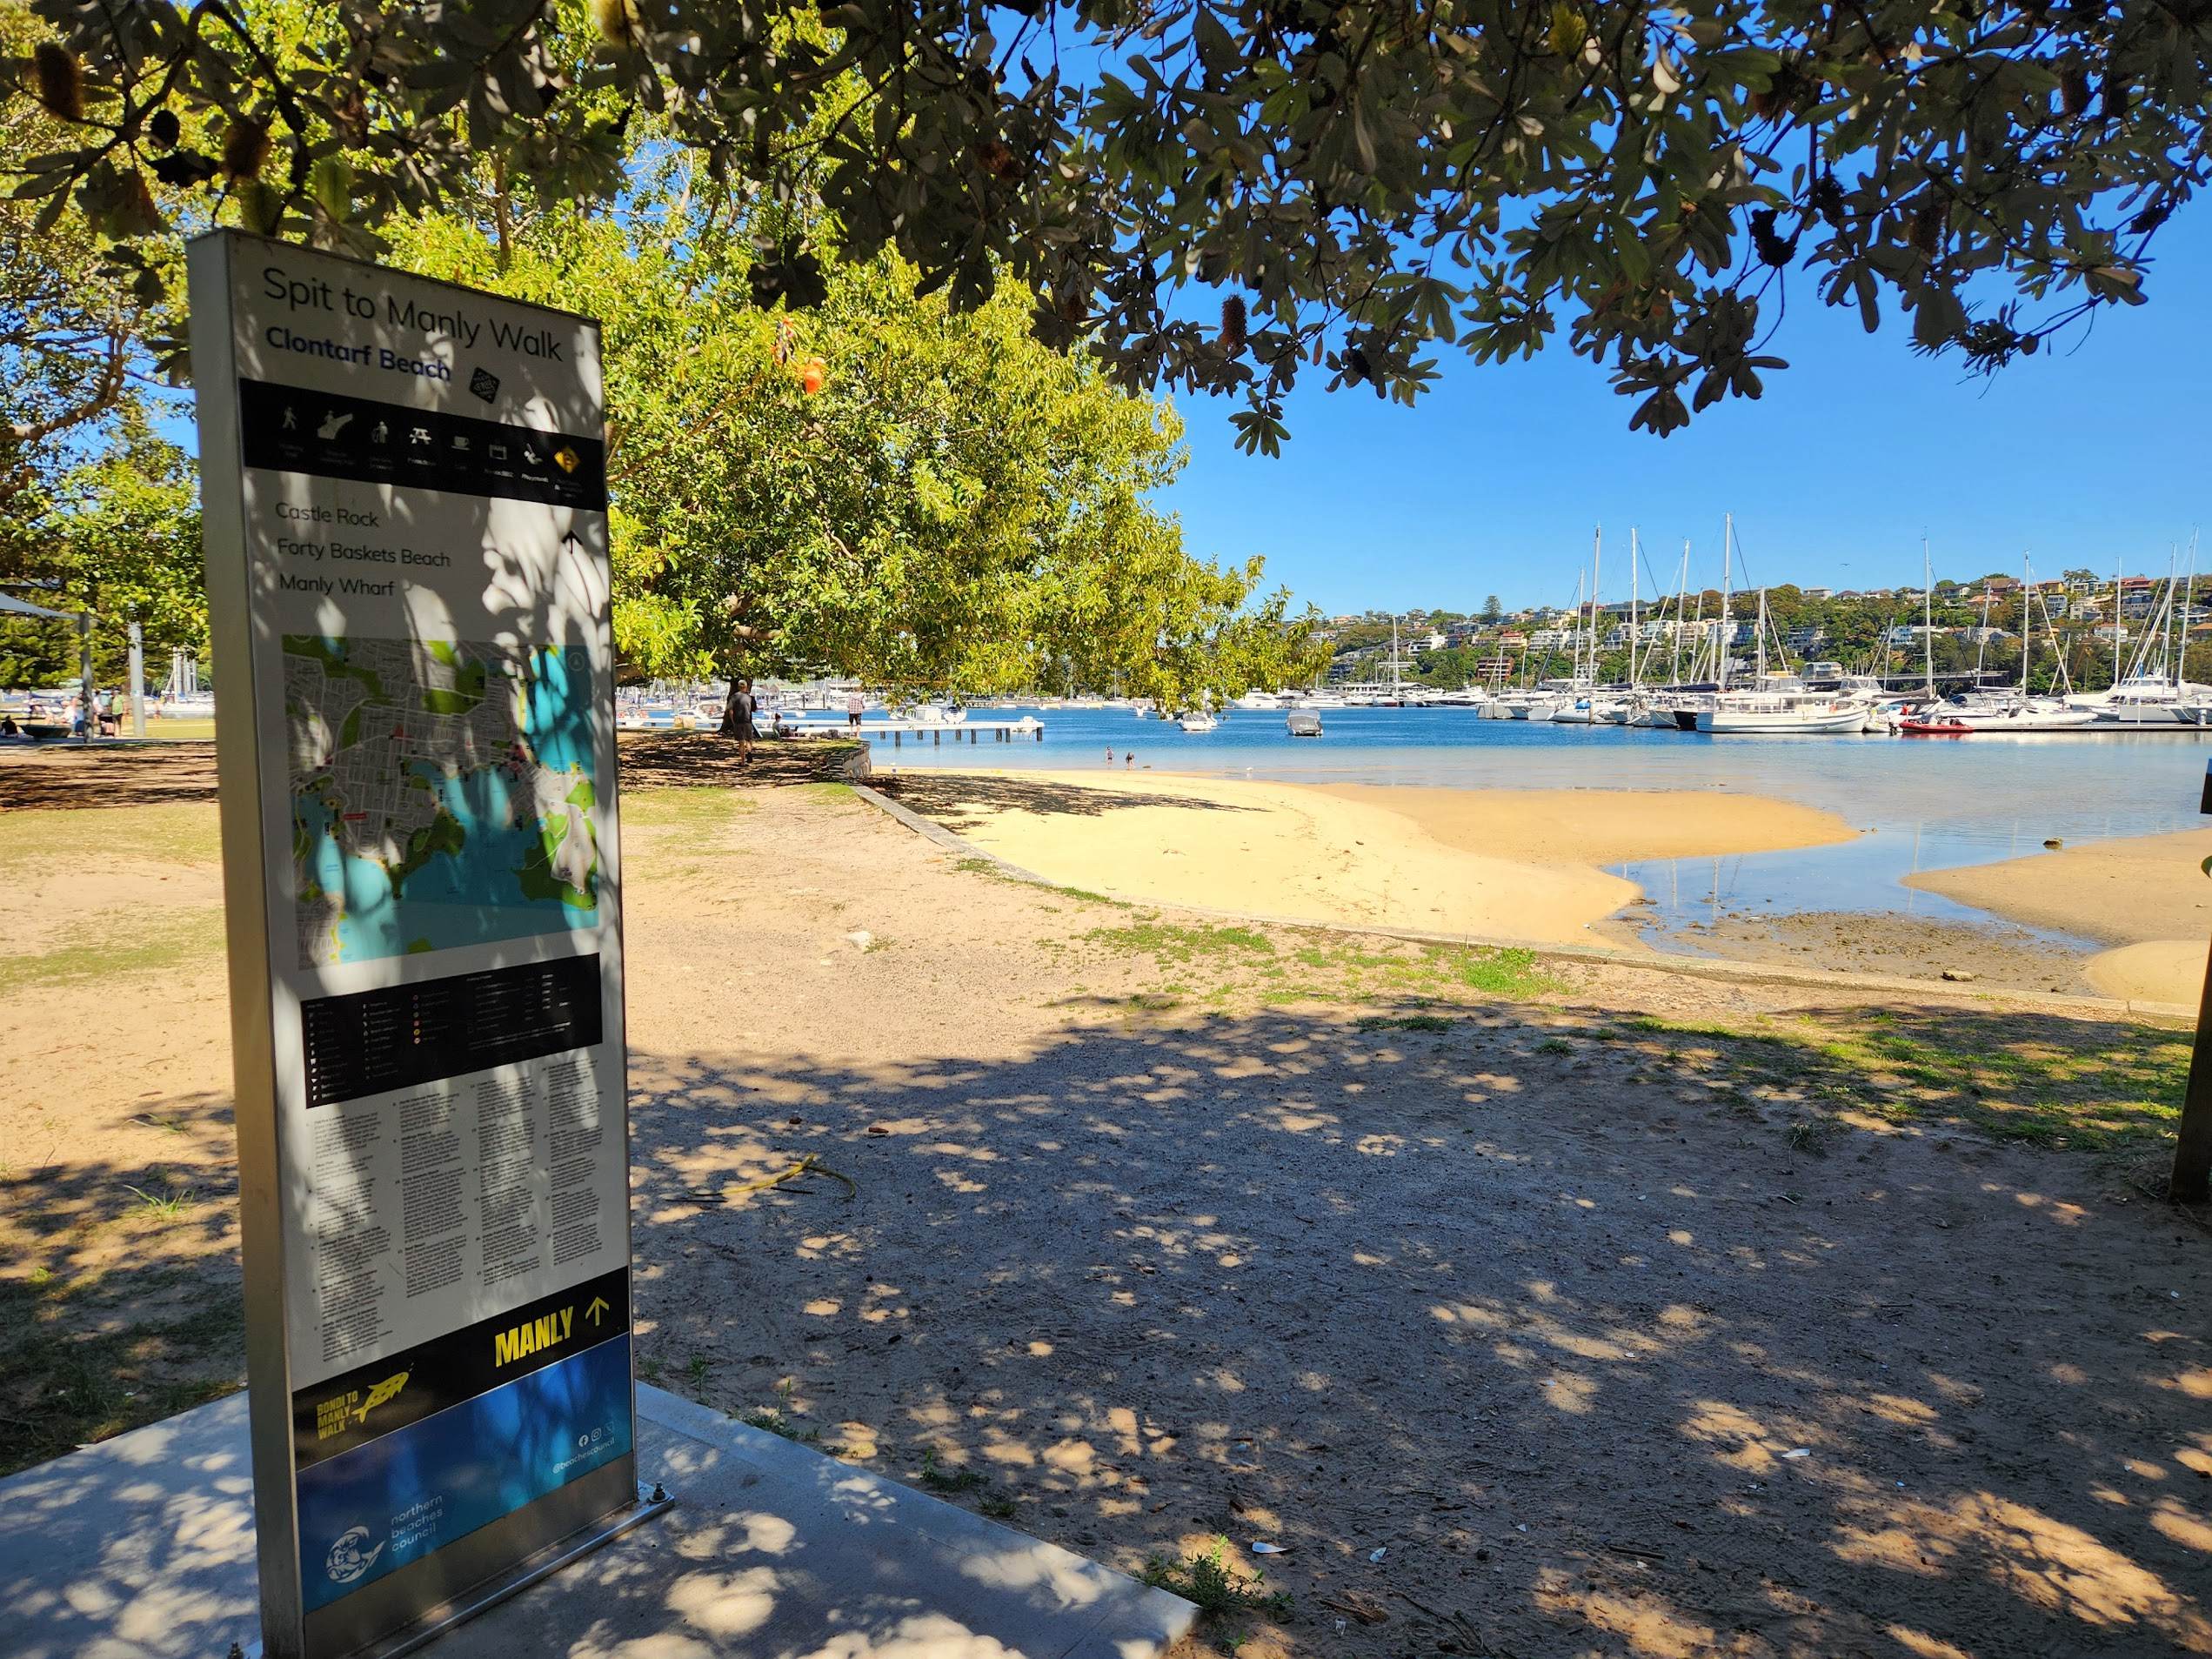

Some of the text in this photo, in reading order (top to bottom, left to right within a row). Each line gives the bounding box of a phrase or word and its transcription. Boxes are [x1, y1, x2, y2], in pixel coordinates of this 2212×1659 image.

[263, 267, 563, 362] Spit to Manly Walk
[265, 327, 451, 381] Clontarf Beach
[275, 502, 379, 528] Castle Rock
[277, 538, 451, 568] Forty Baskets Beach
[279, 573, 397, 596] Manly Wharf
[495, 1306, 574, 1368] MANLY
[317, 1390, 358, 1416] BONDI TO
[317, 1404, 351, 1428] MANLY
[317, 1419, 346, 1441] WALK
[391, 1495, 444, 1525] northern
[391, 1508, 444, 1539] beaches
[391, 1522, 437, 1553] council
